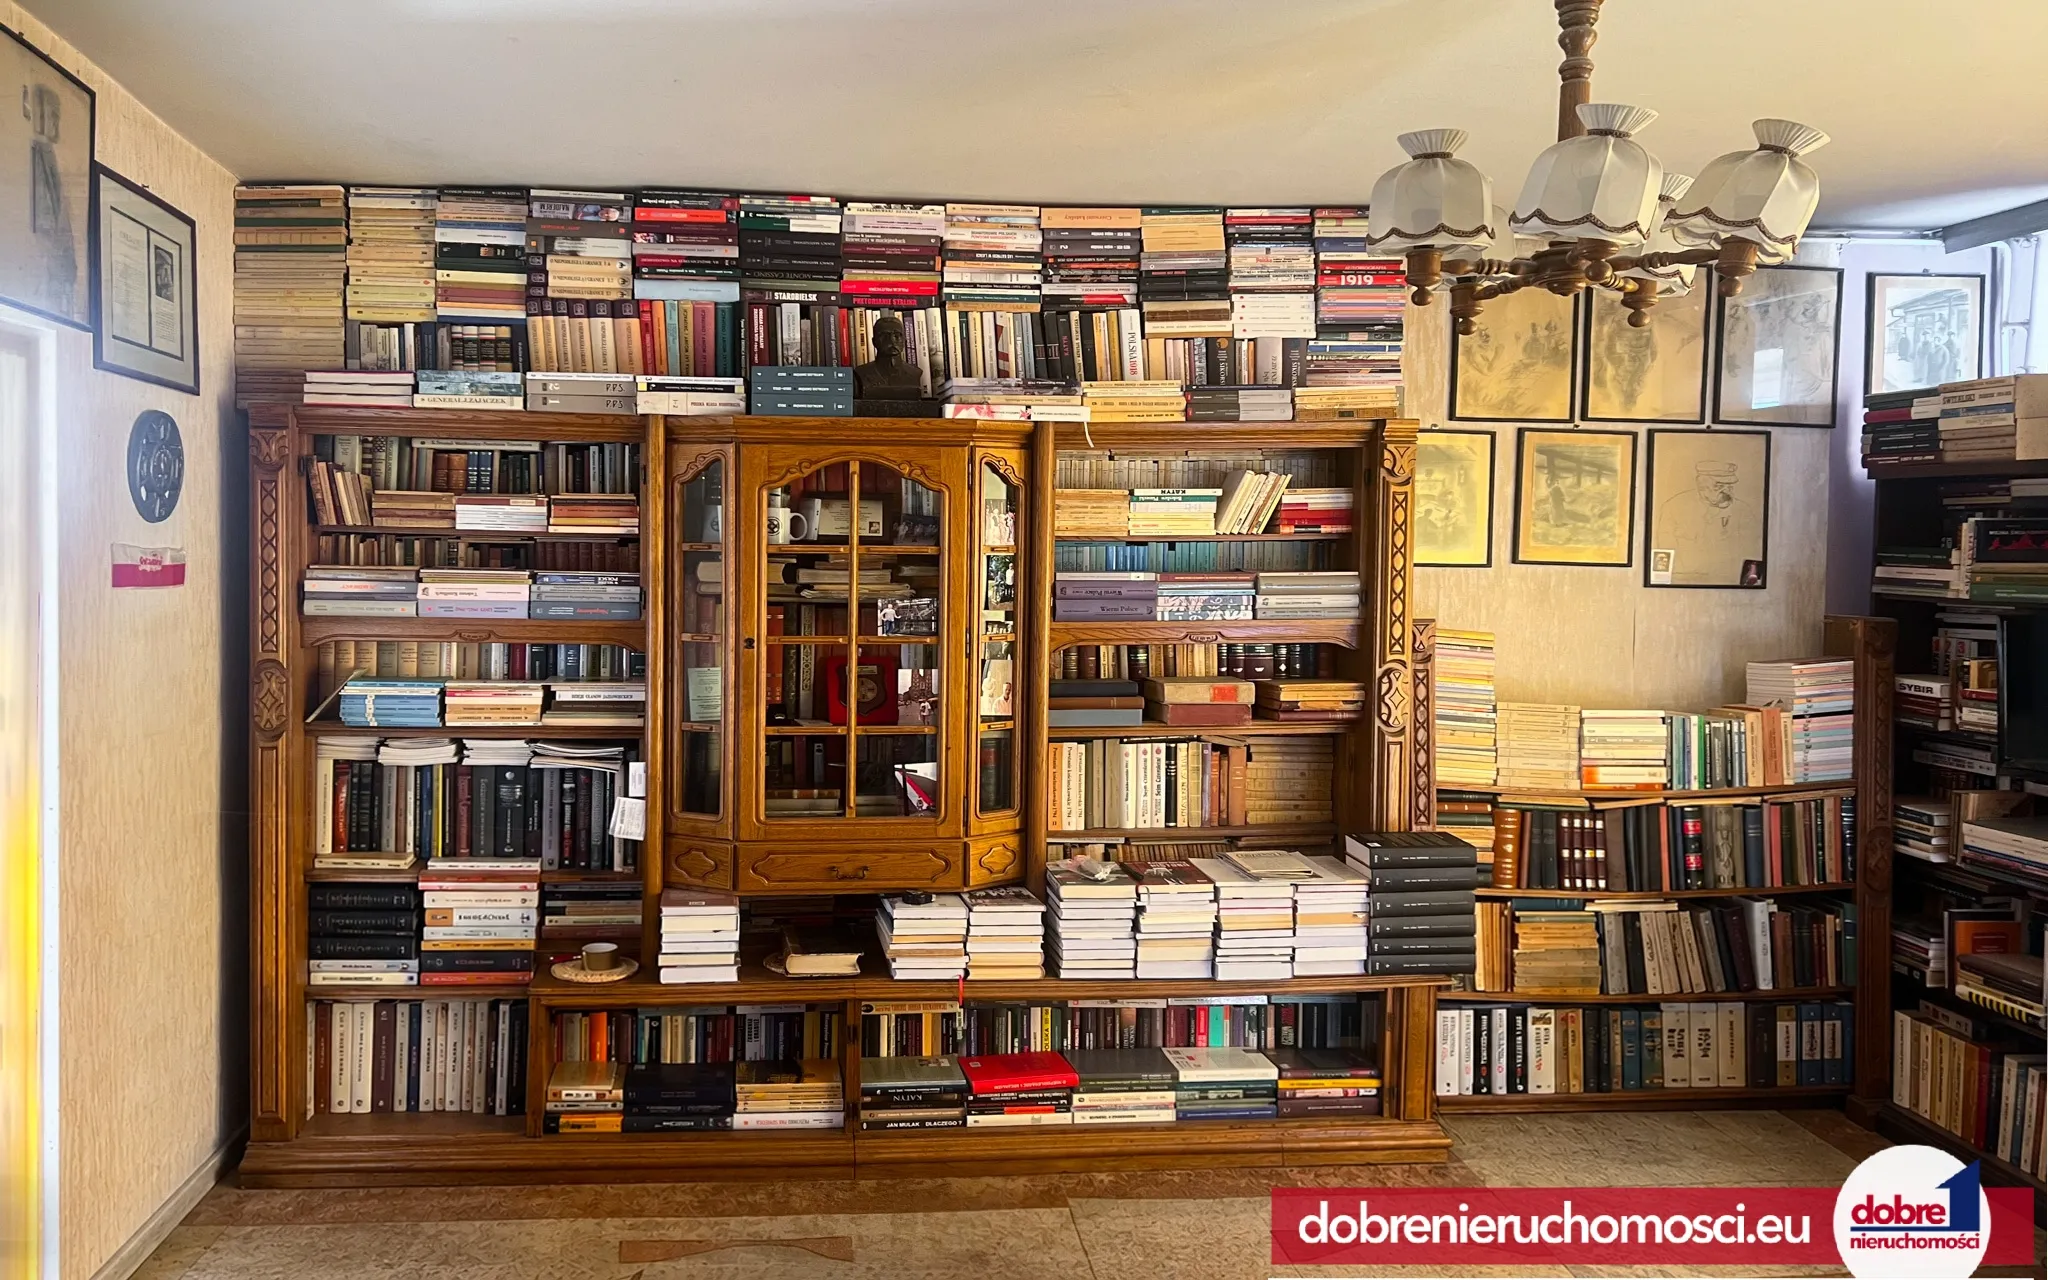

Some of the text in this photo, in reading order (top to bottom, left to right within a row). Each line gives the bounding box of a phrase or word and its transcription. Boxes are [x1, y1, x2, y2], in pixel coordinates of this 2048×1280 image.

[1340, 274, 1374, 286] 1919
[774, 292, 817, 301] STAROBIELSK
[1900, 682, 1934, 695] SYBIR
[886, 1121, 899, 1129] JAN
